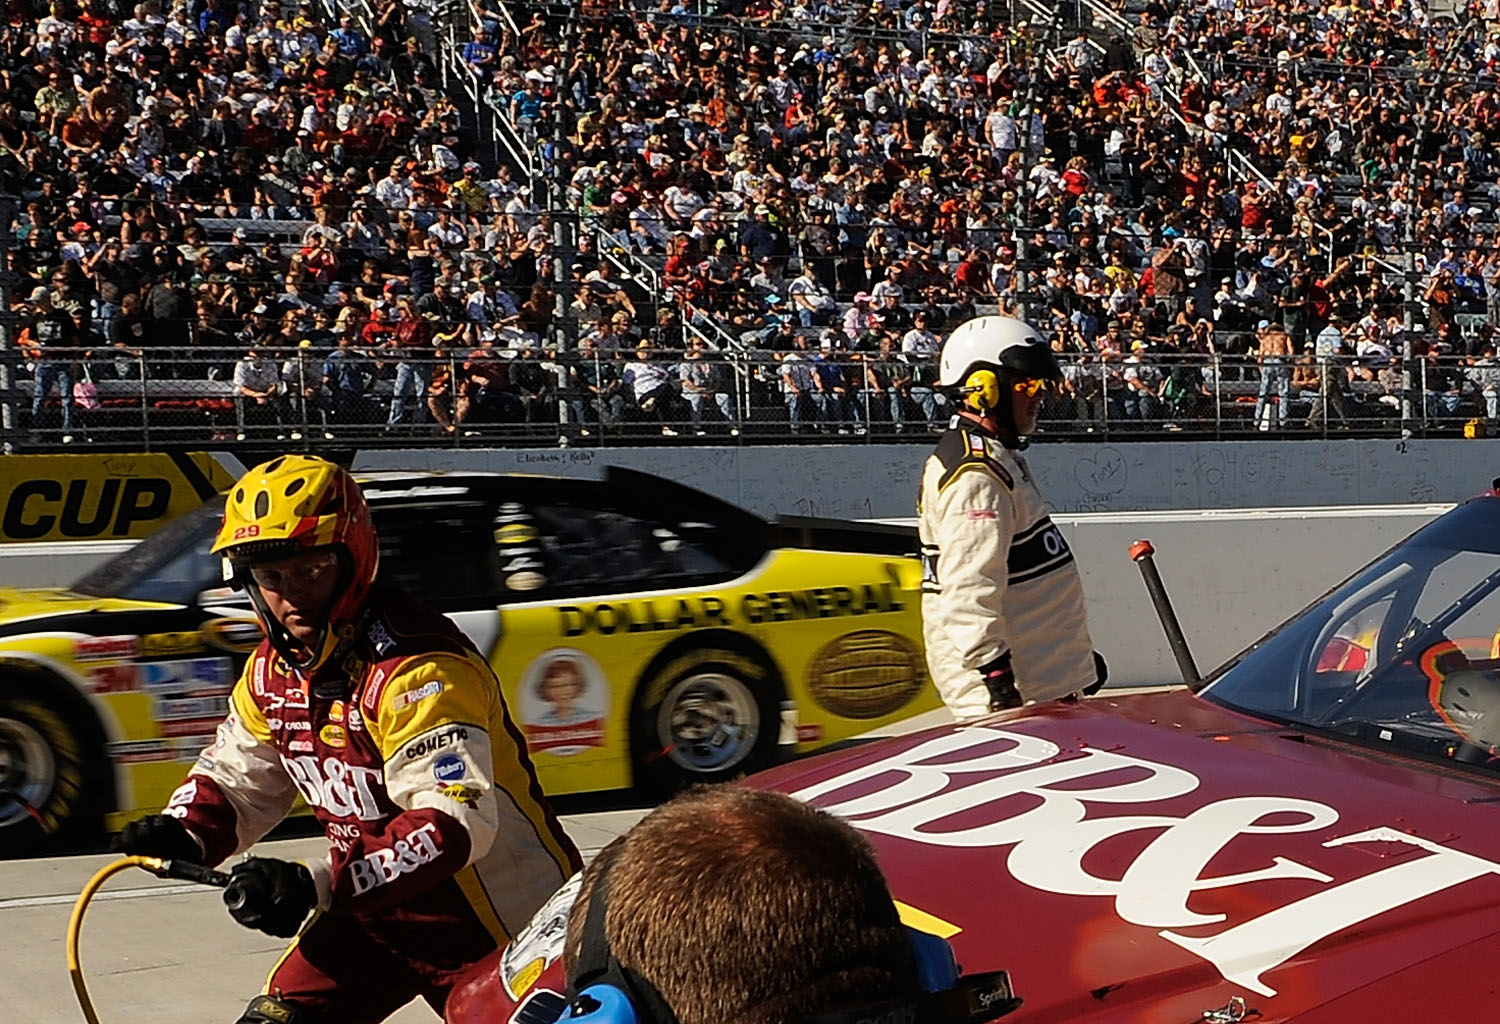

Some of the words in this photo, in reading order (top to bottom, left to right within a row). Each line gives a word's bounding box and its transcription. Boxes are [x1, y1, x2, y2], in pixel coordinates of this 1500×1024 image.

[3, 478, 172, 538] CUP
[234, 525, 260, 540] 29
[561, 598, 726, 637] DOLLAR
[744, 583, 907, 627] GENERAL
[406, 728, 468, 759] COMETIC
[350, 822, 443, 897] BB&T
